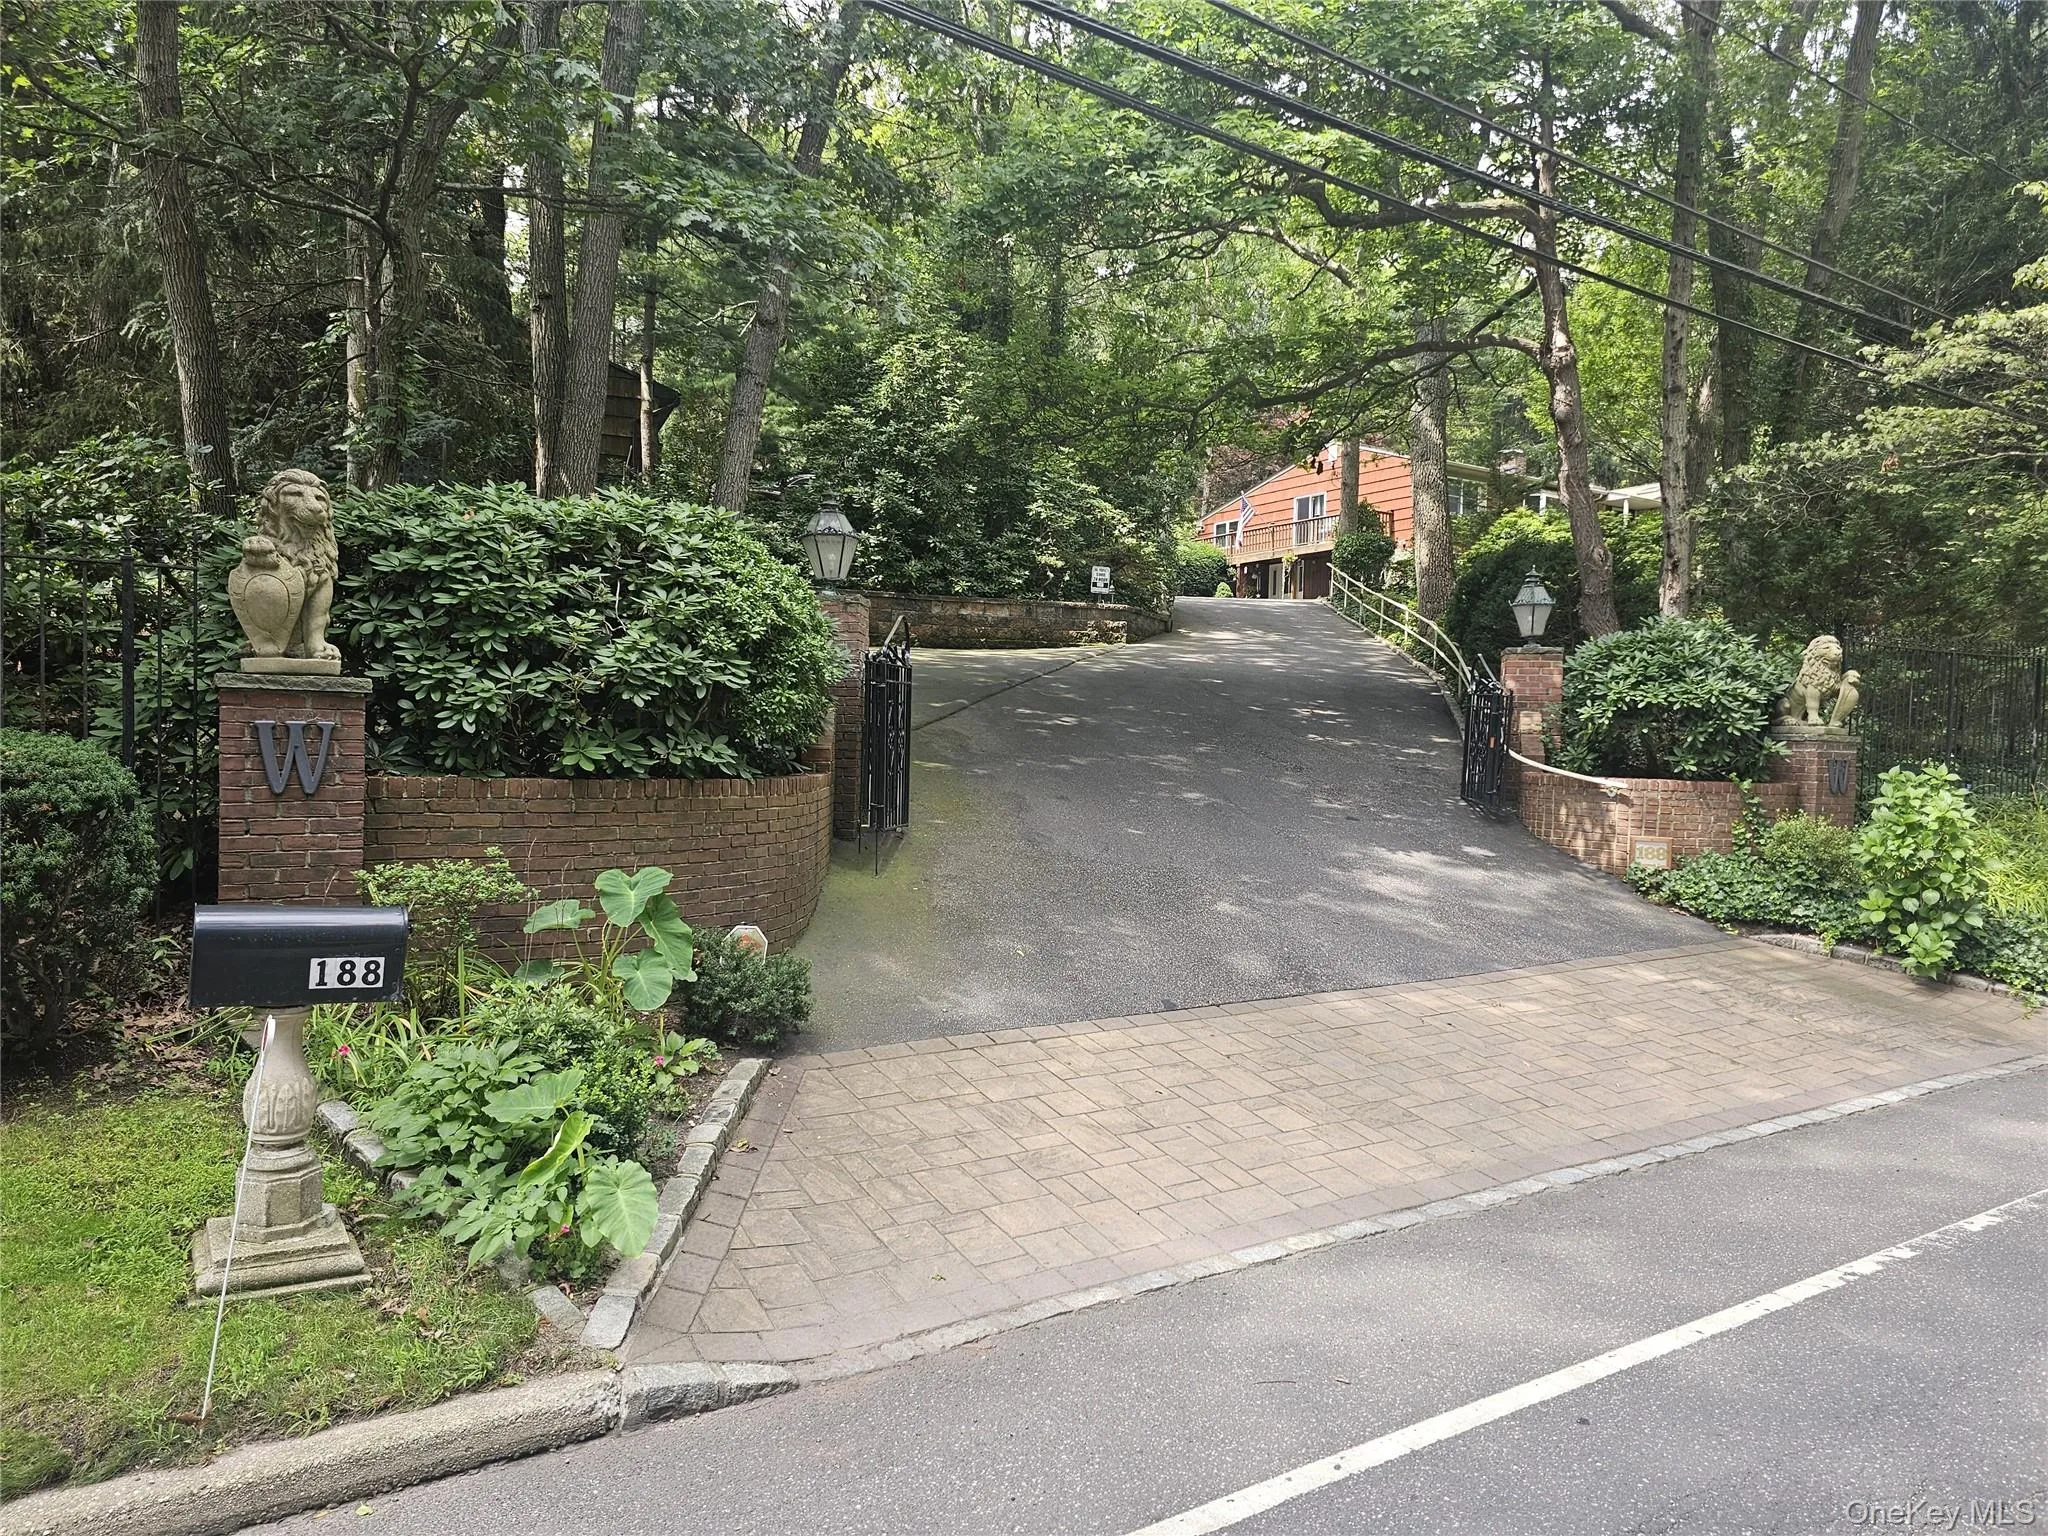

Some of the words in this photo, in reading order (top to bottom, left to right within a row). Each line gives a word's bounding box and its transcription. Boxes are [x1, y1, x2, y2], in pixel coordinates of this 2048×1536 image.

[255, 720, 335, 796] W
[1827, 759, 1849, 794] W
[1636, 846, 1667, 860] 188
[315, 960, 381, 987] 188
